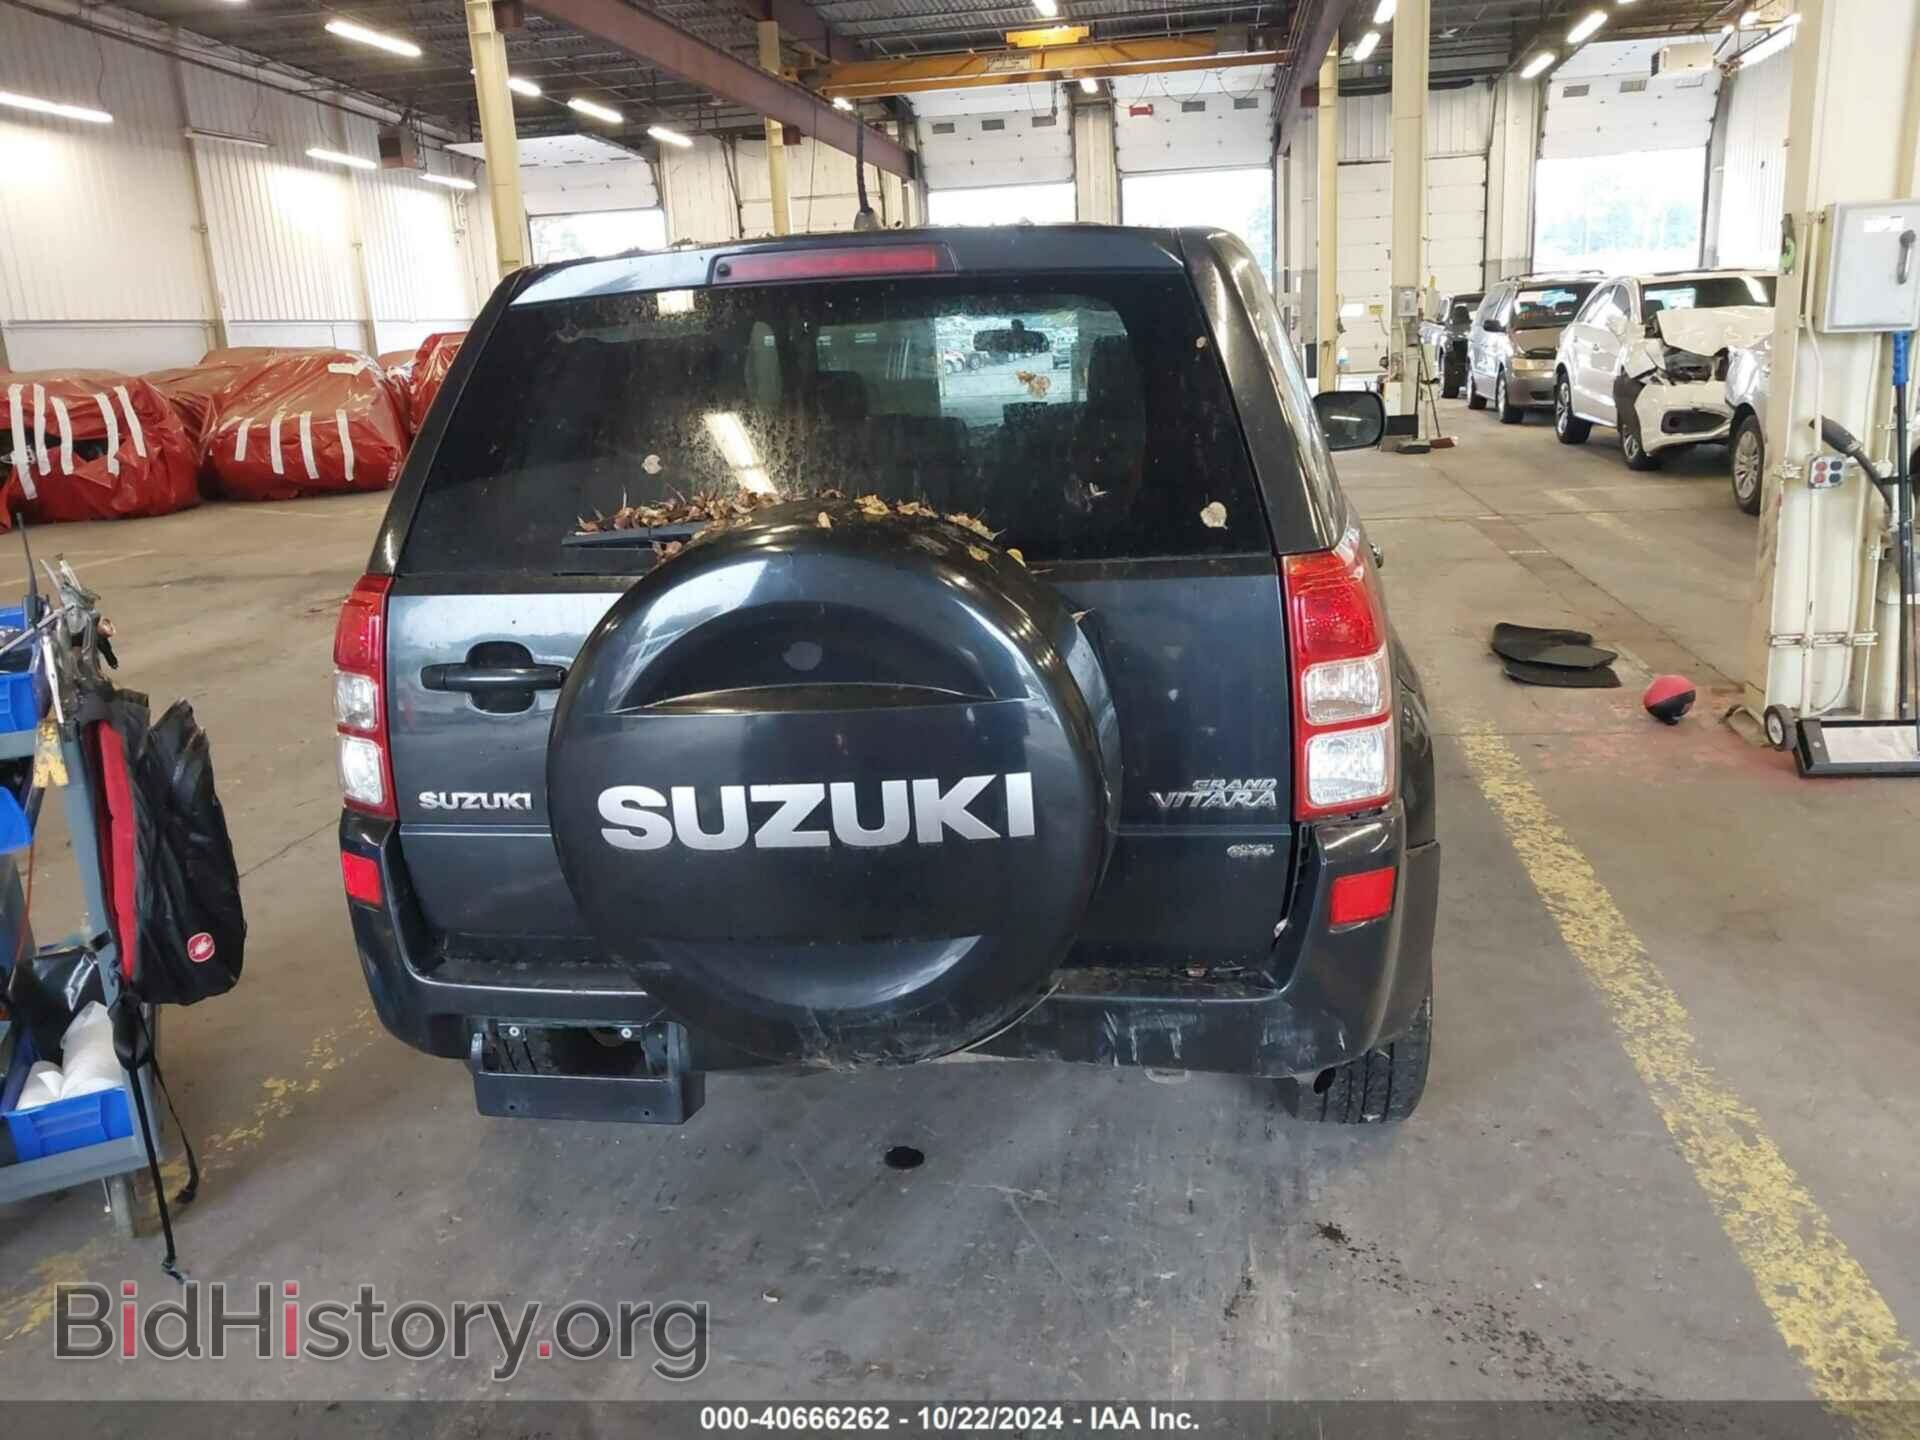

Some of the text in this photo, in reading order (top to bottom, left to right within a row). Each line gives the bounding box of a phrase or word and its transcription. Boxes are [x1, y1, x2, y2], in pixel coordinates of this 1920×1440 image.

[1192, 777, 1278, 791] GRAND
[418, 791, 532, 810] SUZUKI
[1151, 790, 1278, 808] VITARA
[597, 771, 1036, 851] SUZUKI
